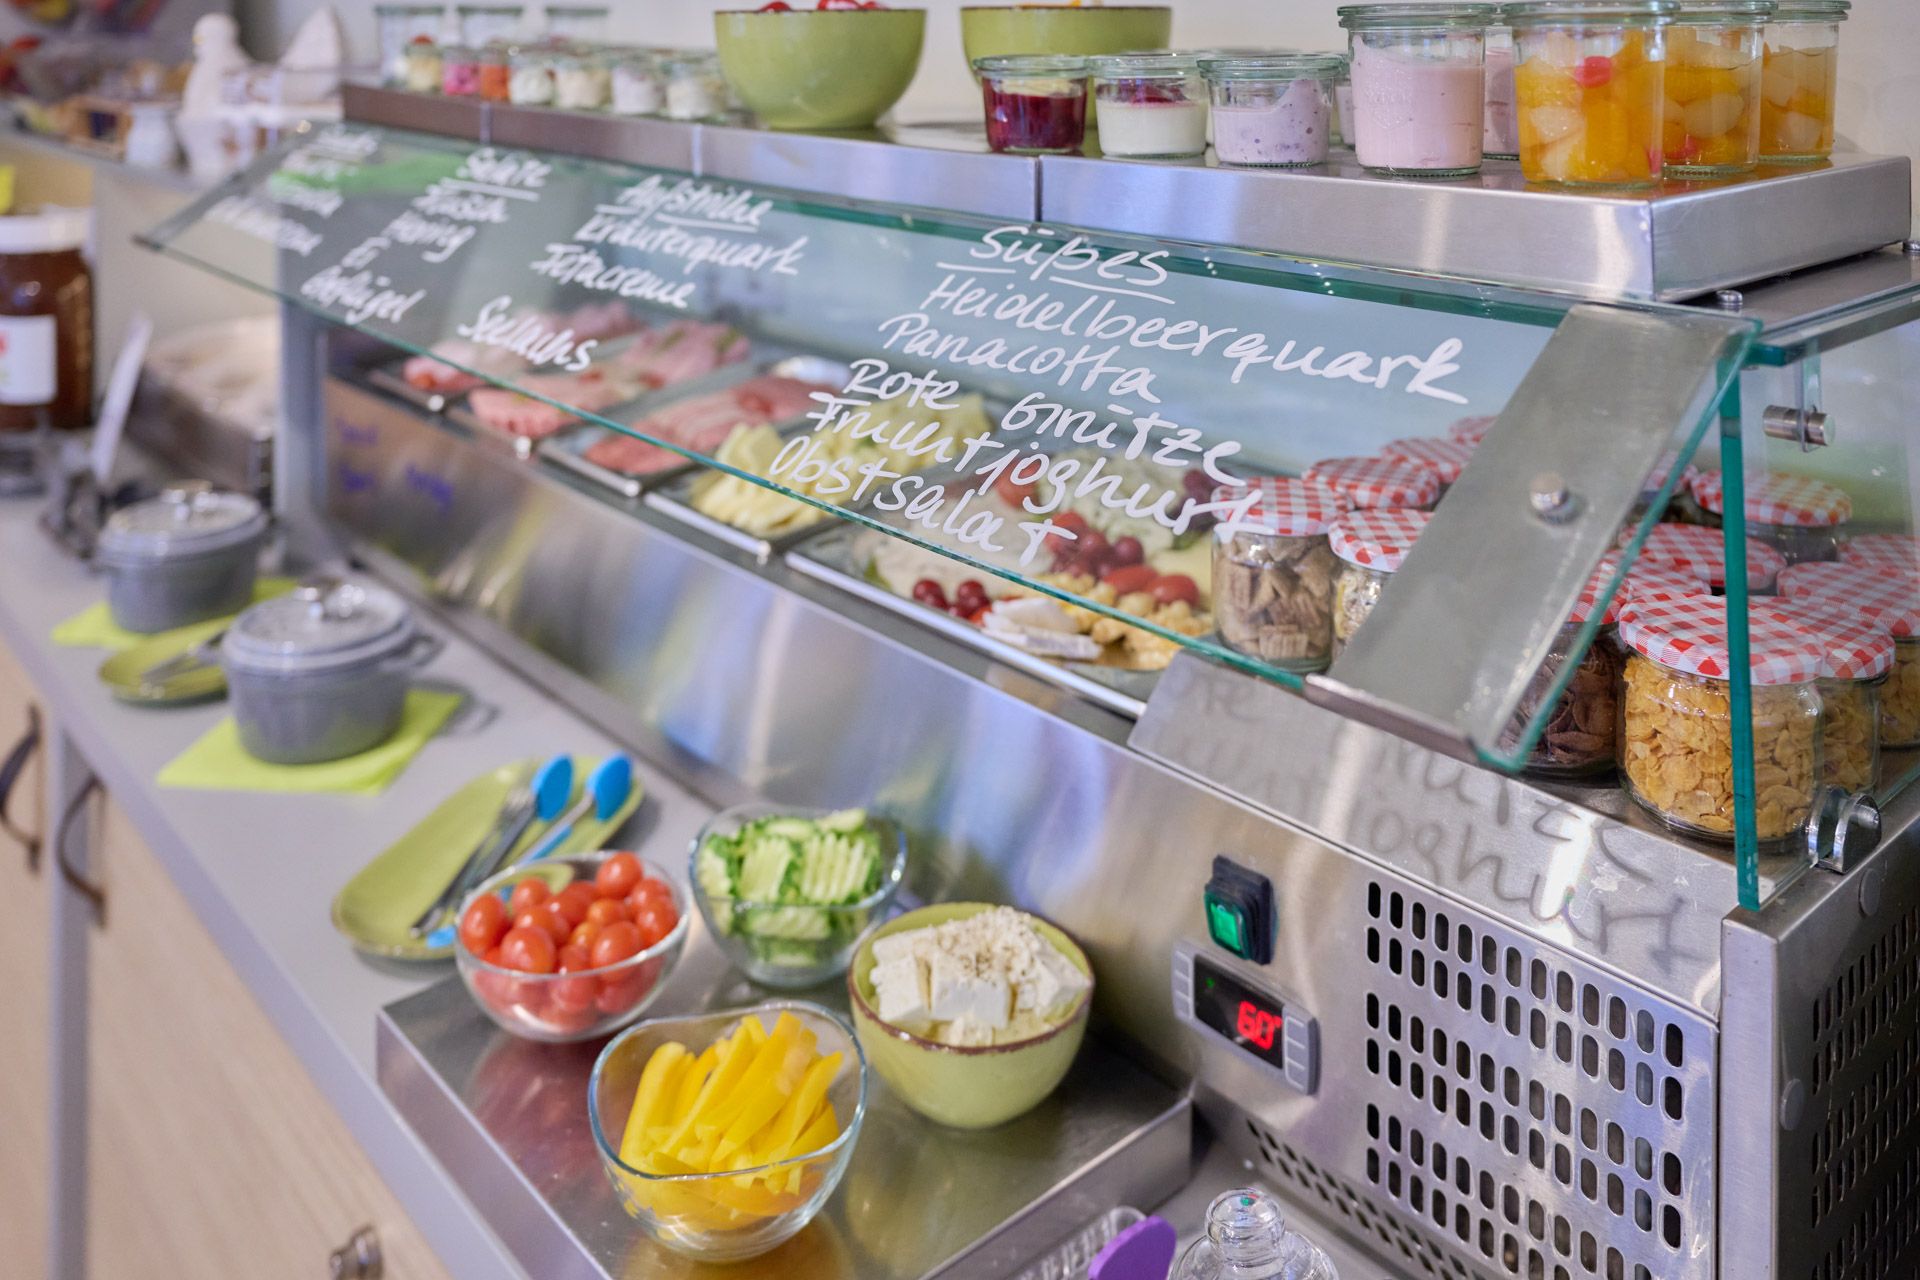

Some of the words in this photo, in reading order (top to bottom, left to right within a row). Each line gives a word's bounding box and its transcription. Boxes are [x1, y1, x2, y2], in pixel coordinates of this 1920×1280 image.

[969, 225, 1170, 287] Süßes
[877, 312, 1162, 404] Panacotta
[919, 273, 1469, 404] Heidelbeerquark
[842, 358, 961, 411] Rote
[1000, 391, 1247, 487] Grütze
[768, 435, 1079, 568] Obstsalat
